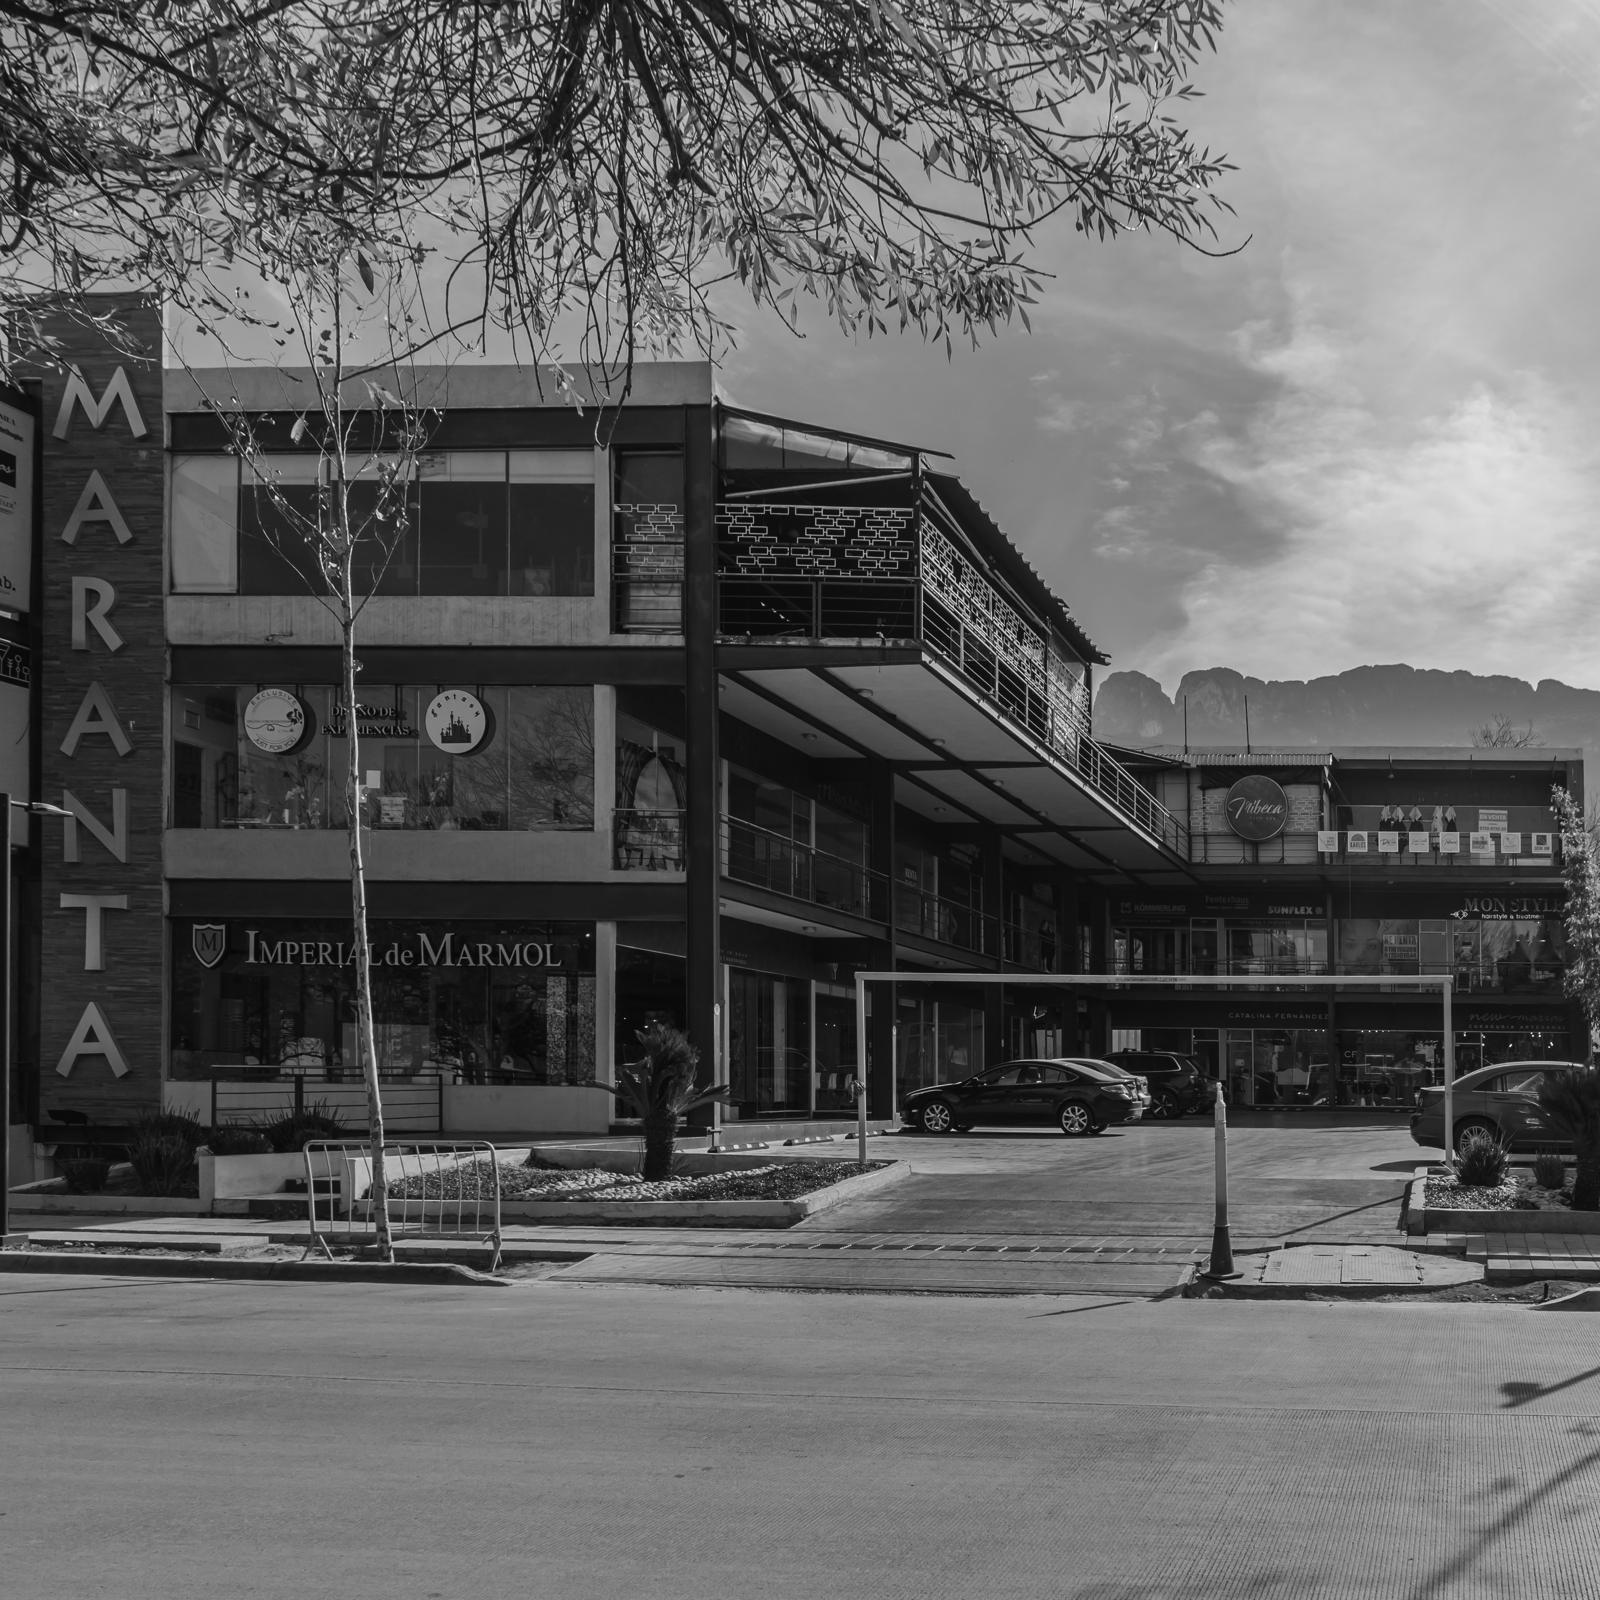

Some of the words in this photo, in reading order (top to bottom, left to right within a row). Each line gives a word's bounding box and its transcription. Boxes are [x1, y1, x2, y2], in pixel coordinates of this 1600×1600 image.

[251, 690, 297, 705] EXCLUSIVE
[379, 706, 395, 717] DE
[52, 363, 148, 1079] MARANTA
[1227, 797, 1285, 819] Tribeca
[1267, 905, 1313, 915] SUNFLEX
[1464, 898, 1506, 912] MON
[199, 931, 218, 954] M
[385, 941, 413, 967] de
[1228, 1011, 1271, 1019] CATALINA
